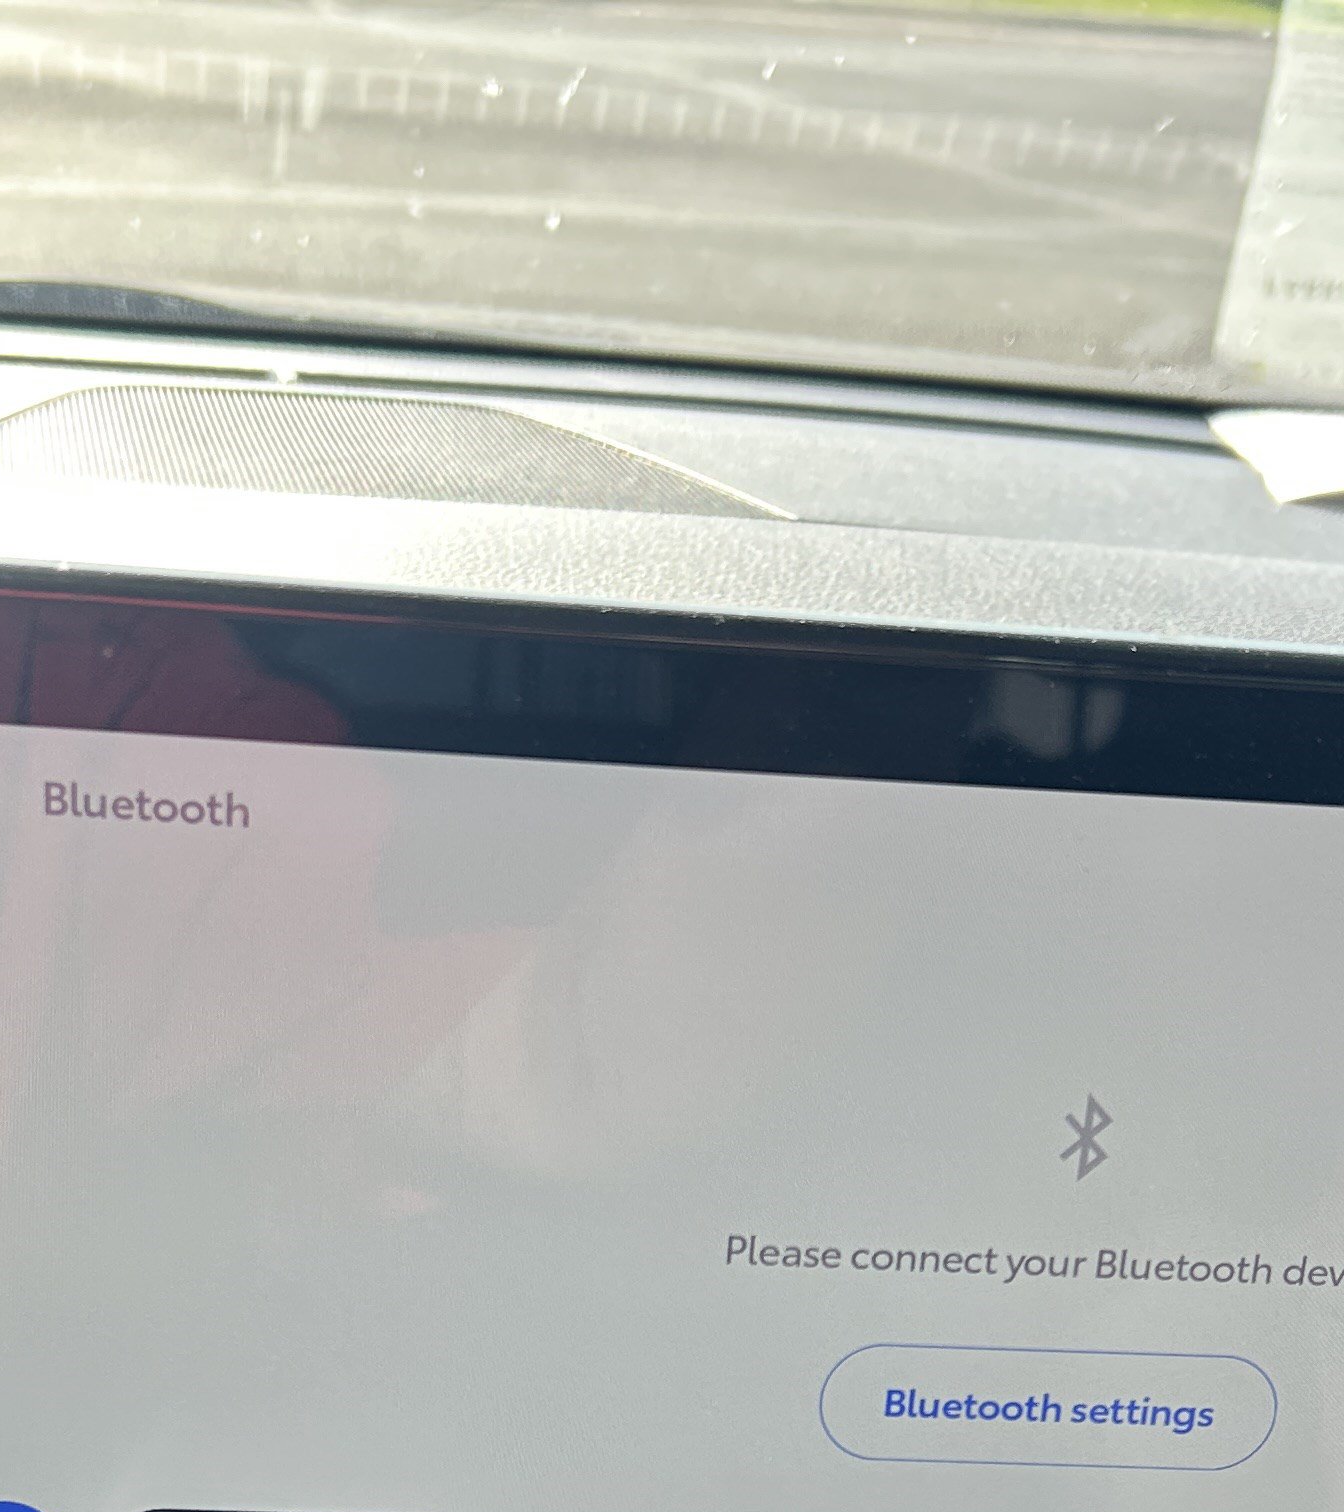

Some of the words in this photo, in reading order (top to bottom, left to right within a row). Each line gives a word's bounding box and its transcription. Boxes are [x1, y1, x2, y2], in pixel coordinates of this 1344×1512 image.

[43, 781, 251, 829] Bluetooth
[725, 1235, 841, 1270] Please
[850, 1246, 998, 1278] connect
[1003, 1250, 1087, 1283] your
[1095, 1249, 1273, 1286] Bluetooth
[884, 1389, 1063, 1425] Bluetooth
[1070, 1396, 1215, 1435] settings
